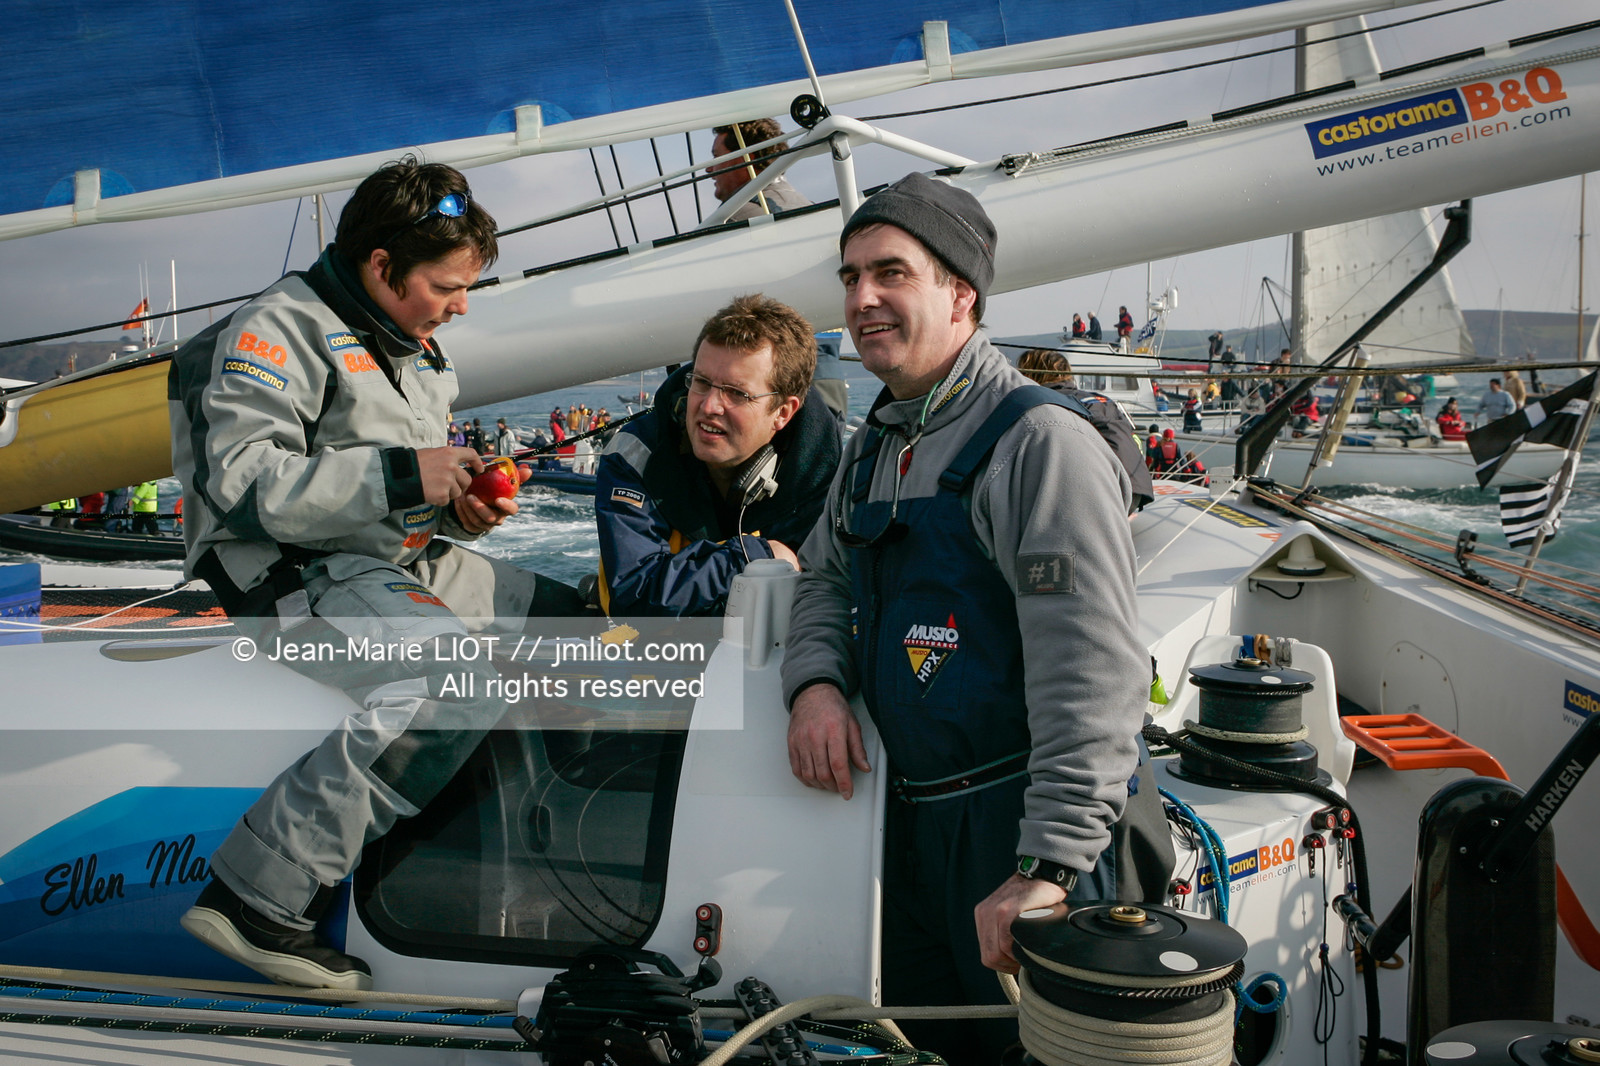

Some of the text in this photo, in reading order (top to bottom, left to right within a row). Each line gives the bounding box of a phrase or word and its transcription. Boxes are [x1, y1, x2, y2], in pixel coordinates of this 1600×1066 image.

[1318, 67, 1567, 146] castorama B&Q
[1317, 105, 1571, 176] www.teamellen.com
[236, 331, 287, 368] B&Q
[225, 361, 285, 390] castorama
[1028, 558, 1061, 585] #1
[903, 639, 959, 650] PERFORMANCE
[905, 624, 959, 643] MUSTO
[917, 651, 941, 683] HPX
[1524, 758, 1585, 832] HARKEN
[1200, 837, 1296, 886] carama B&Q
[40, 853, 125, 916] Ellen
